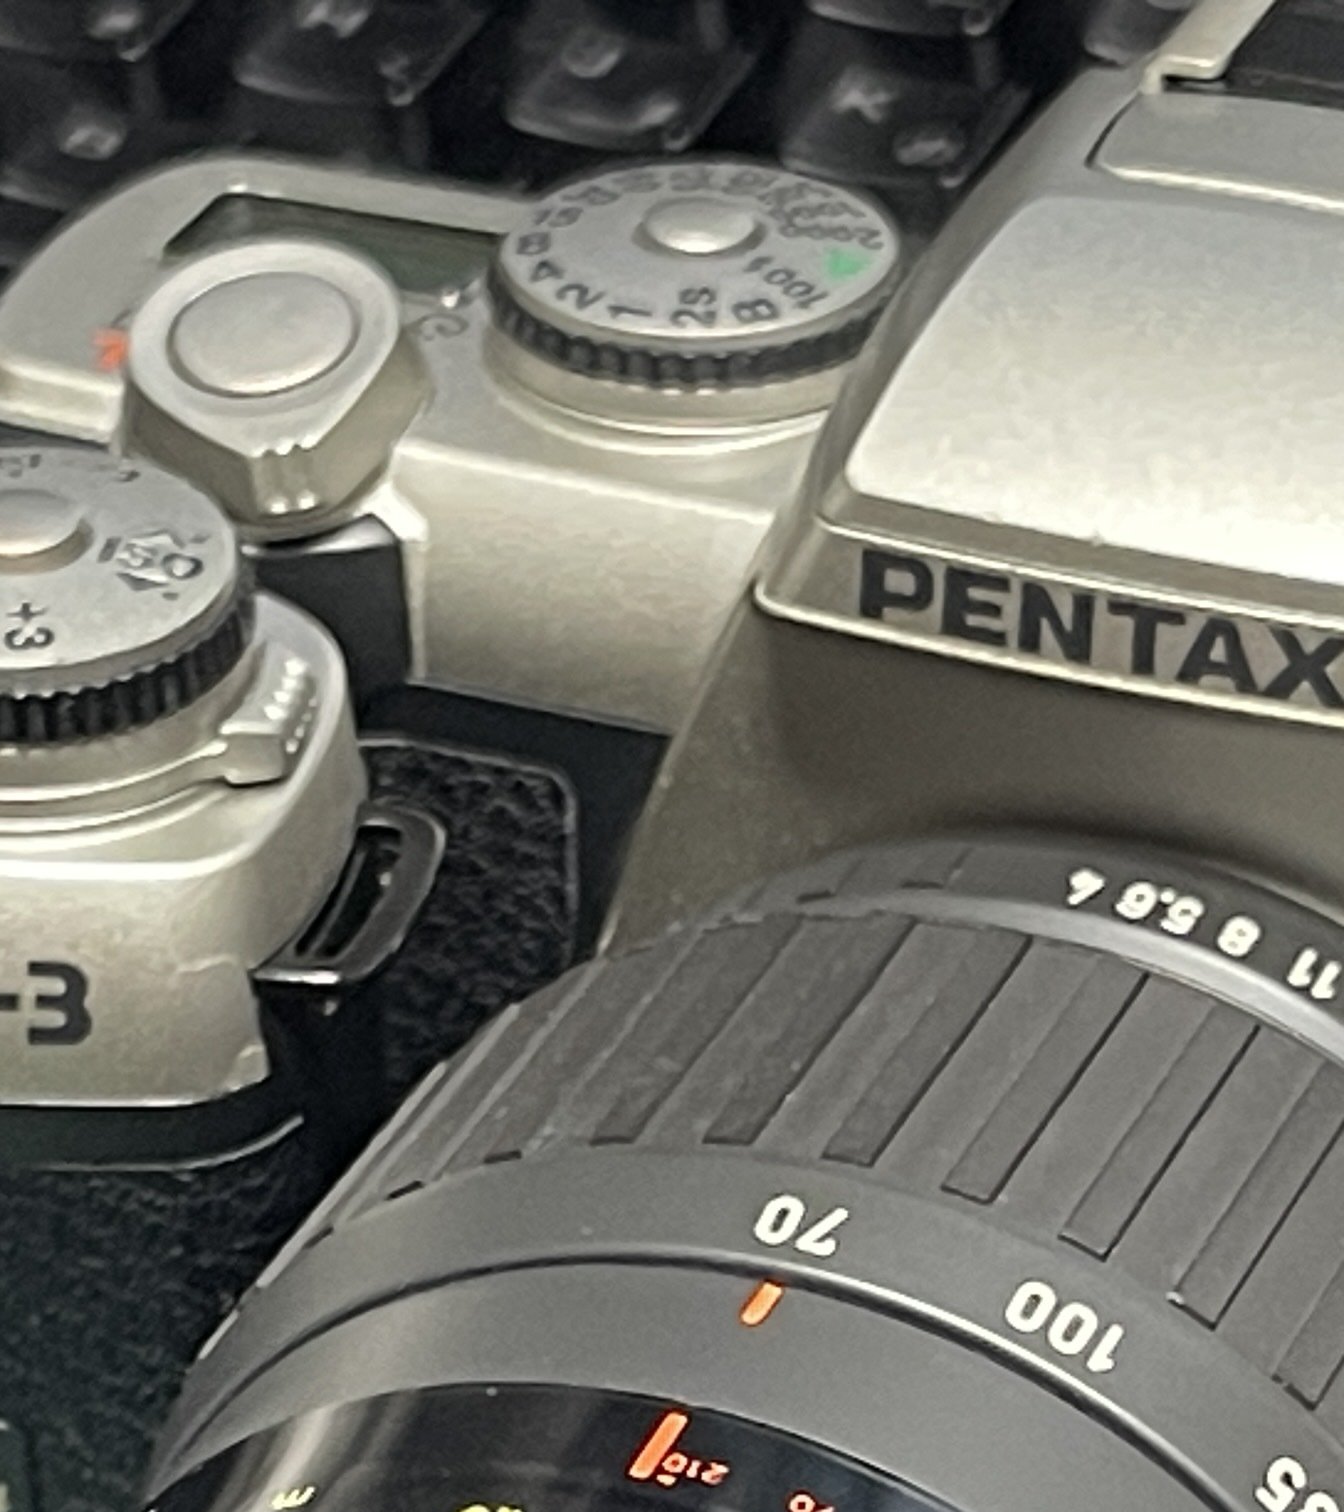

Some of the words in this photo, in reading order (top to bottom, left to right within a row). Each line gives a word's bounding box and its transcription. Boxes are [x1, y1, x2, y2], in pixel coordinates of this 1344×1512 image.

[1065, 868, 1106, 906] 4
[1216, 915, 1262, 958] 8
[1285, 946, 1343, 1001] 11
[752, 1194, 850, 1258] 70
[1003, 1279, 1127, 1374] 100
